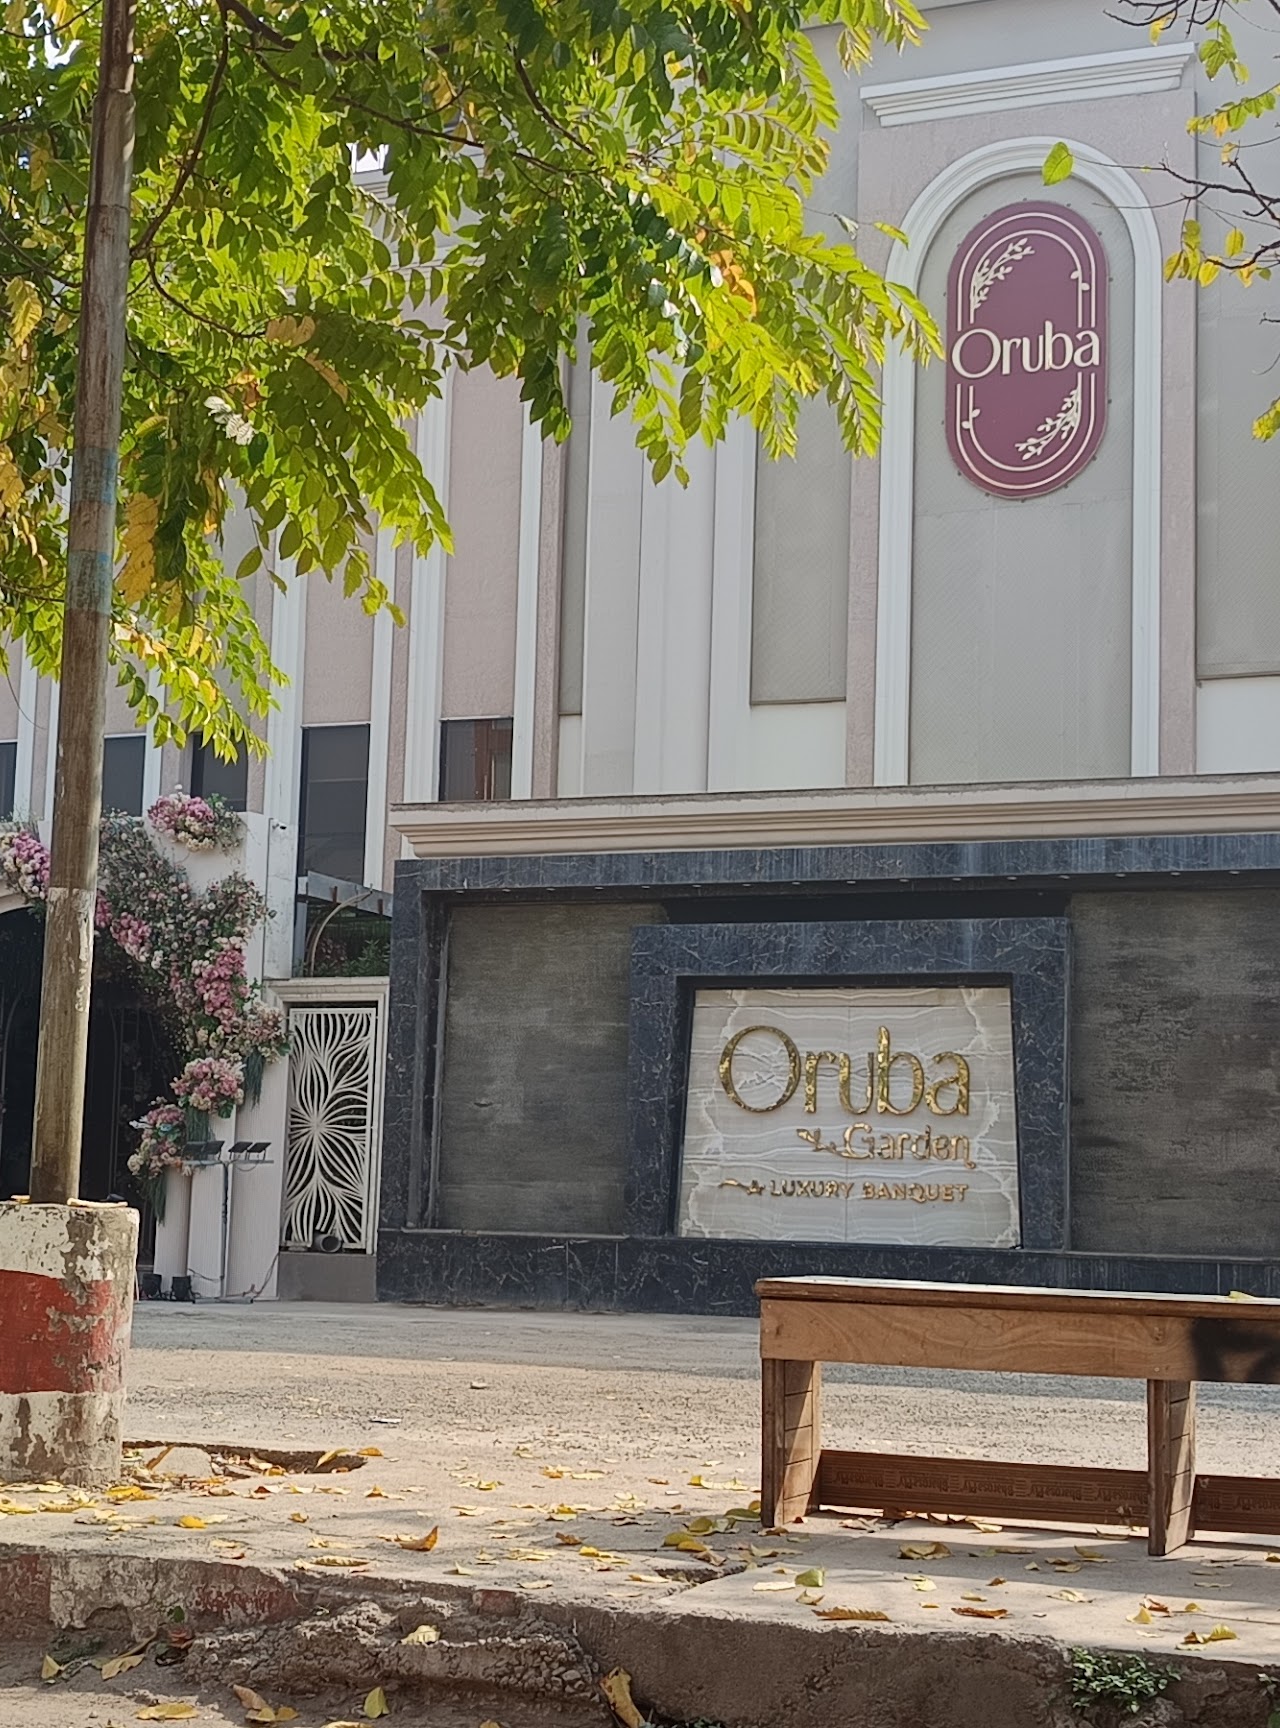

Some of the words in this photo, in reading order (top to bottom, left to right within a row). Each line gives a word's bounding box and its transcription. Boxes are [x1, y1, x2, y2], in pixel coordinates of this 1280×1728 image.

[951, 320, 1100, 379] Oruba
[719, 1025, 969, 1115] Oruba
[841, 1122, 976, 1169] Garden
[770, 1181, 854, 1198] LUXURY
[862, 1182, 969, 1203] BANQUET
